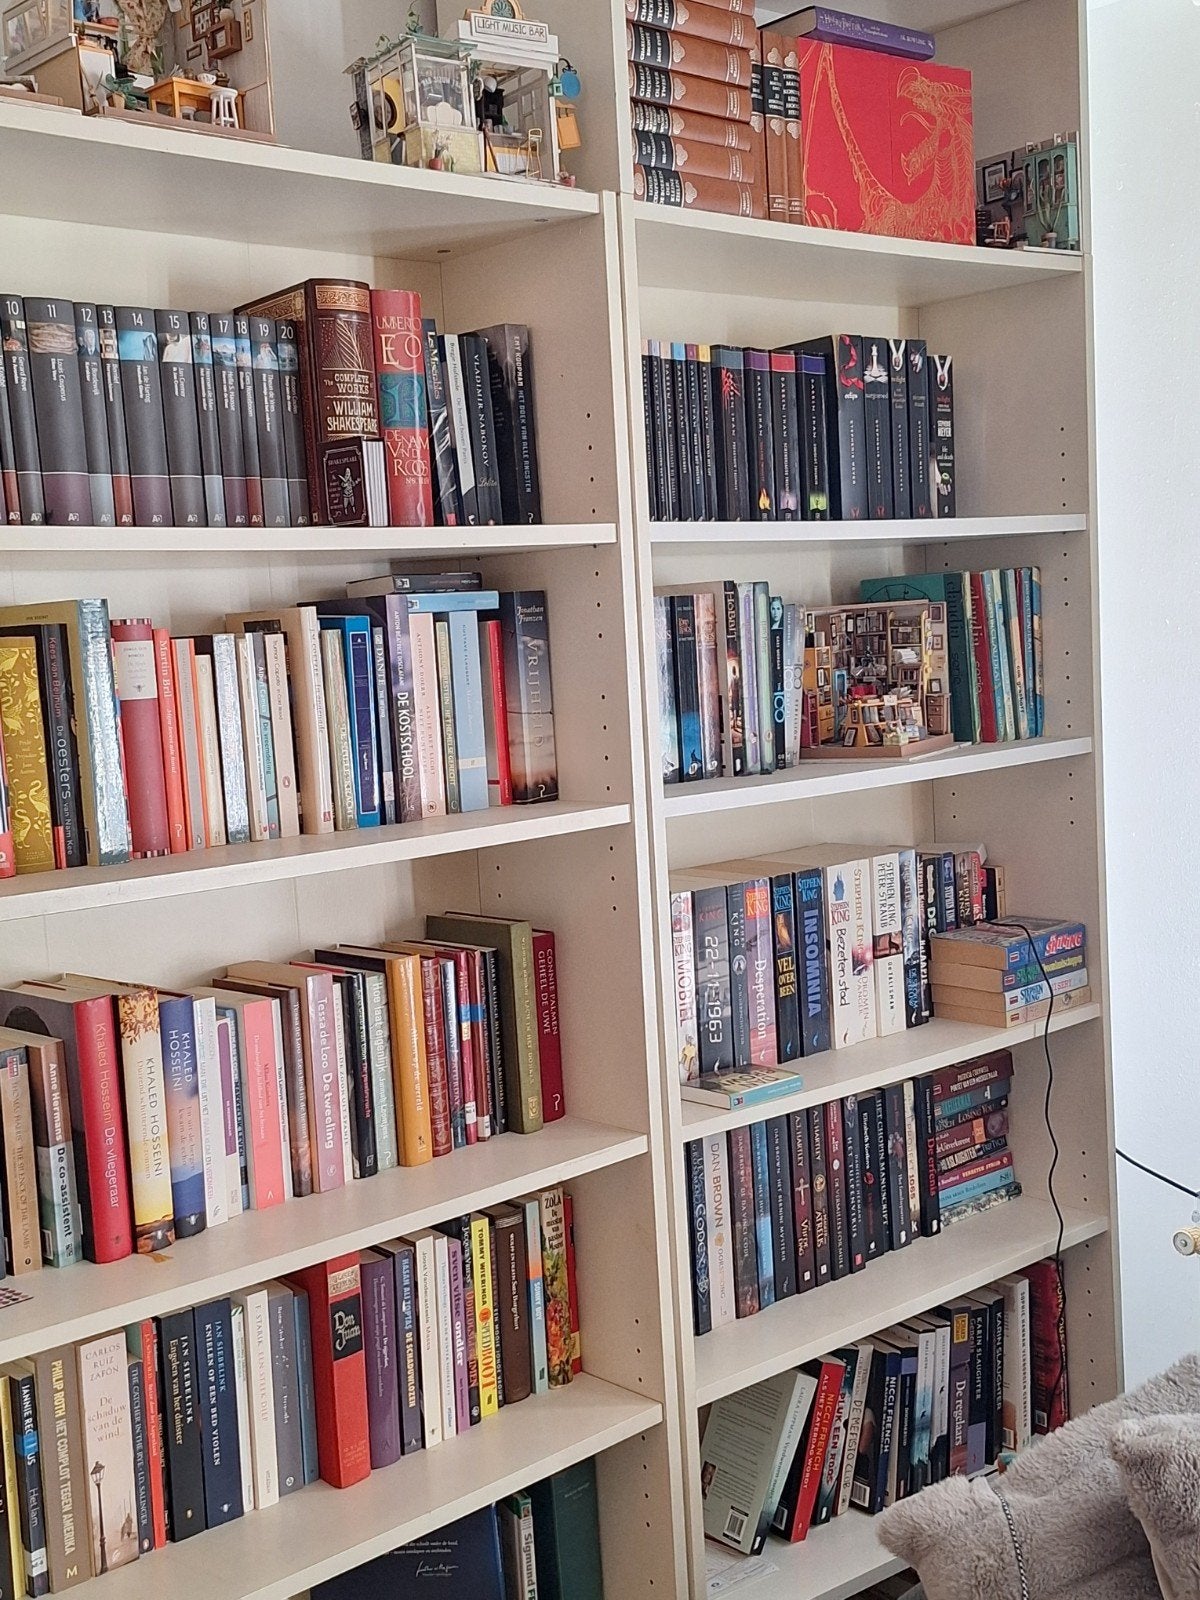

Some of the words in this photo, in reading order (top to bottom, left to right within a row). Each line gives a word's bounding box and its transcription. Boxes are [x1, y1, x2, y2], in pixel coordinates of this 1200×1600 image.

[477, 19, 500, 31] LIGHT
[502, 22, 527, 35] MUSIC
[529, 25, 545, 38] BAR
[6, 301, 19, 316] 10
[47, 304, 57, 318] 11
[81, 308, 92, 323] 12
[102, 310, 113, 324] 13
[132, 312, 144, 326] 14
[169, 315, 180, 329] 15
[196, 317, 207, 331] 16
[218, 320, 229, 333] 17
[236, 321, 247, 335] 18
[259, 323, 270, 337] 19
[281, 326, 293, 340] 20
[334, 374, 370, 385] COMPLETE
[514, 351, 523, 387] KOOPMAN
[336, 384, 370, 395] WORKS
[517, 390, 525, 404] HET
[333, 401, 374, 418] WILLIAM
[473, 354, 484, 410] VLADIMIR
[479, 413, 489, 468] NABOKOV
[518, 404, 526, 424] BOEK
[327, 417, 379, 433] SHAKESPEARE
[521, 441, 529, 460] ALLE
[522, 461, 531, 493] ANGSTEN
[49, 637, 58, 660] Kees
[160, 639, 170, 678] Martin
[50, 661, 58, 678] van
[377, 647, 386, 686] DANTE
[52, 679, 62, 718] Beijnum
[162, 679, 172, 698] Bril
[397, 691, 410, 708] DE
[56, 725, 64, 737] De
[263, 721, 270, 732] De
[263, 733, 273, 775] vreemdeling
[398, 709, 415, 783] KOSTSCHOOL
[57, 738, 73, 799] oesters
[65, 818, 73, 838] Nam
[66, 839, 75, 856] Kee
[877, 863, 886, 889] PETER
[886, 861, 896, 903] STEPHEN
[879, 891, 888, 928] STRAUB
[888, 903, 897, 926] KING
[730, 912, 739, 946] KING
[538, 950, 547, 990] GEHEEL
[547, 949, 555, 991] CONNIE
[803, 909, 821, 1018] INSOMNIA
[373, 982, 384, 1003] Hoe
[541, 993, 548, 1006] DE
[705, 936, 722, 1043] 22-11-1963
[752, 960, 769, 1039] Desperation
[839, 980, 849, 1006] stad
[317, 997, 329, 1030] Tessa
[374, 1006, 385, 1027] laat
[543, 1011, 551, 1035] UWE
[550, 993, 559, 1036] PALMEN
[95, 1023, 108, 1066] Khaled
[321, 1031, 330, 1044] de
[169, 1029, 183, 1092] HOSSEINI
[182, 1031, 194, 1083] KHALED
[321, 1045, 331, 1069] Loo
[375, 1030, 387, 1073] eigenlijk
[49, 1063, 59, 1090] Anne
[146, 1057, 158, 1109] KHALED
[323, 1072, 333, 1092] De
[99, 1069, 112, 1124] Hosseini
[51, 1092, 64, 1141] Hermans
[323, 1092, 336, 1149] tweeling
[104, 1126, 116, 1146] De
[150, 1114, 163, 1177] HOSSEINI
[237, 1130, 245, 1157] LEVEN
[876, 1123, 885, 1162] CHOPIN
[57, 1147, 66, 1164] De
[710, 1142, 721, 1172] DAN
[104, 1149, 120, 1208] vliegeraar
[59, 1166, 73, 1238] co-assistent
[545, 1194, 561, 1209] ZOLA
[712, 1174, 723, 1228] BROWN
[848, 1163, 857, 1239] TULPENVIRUS
[879, 1163, 888, 1226] MANUSCRIPT
[478, 1228, 486, 1261] TOMMY
[401, 1259, 411, 1286] HASAN
[451, 1250, 460, 1283] sven
[480, 1262, 488, 1306] WIERINGA
[453, 1285, 462, 1317] vitse
[214, 1321, 223, 1339] JAN
[334, 1311, 356, 1331] Don
[180, 1335, 189, 1358] JAN
[204, 1323, 215, 1367] KNIELEN
[405, 1331, 414, 1342] DE
[454, 1320, 465, 1366] ondier
[86, 1344, 121, 1360] CARLOS
[94, 1356, 114, 1369] RUIZ
[168, 1339, 180, 1377] Engelen
[51, 1360, 65, 1391] PHILIP
[131, 1367, 140, 1384] THE
[208, 1369, 217, 1383] OP
[216, 1341, 227, 1393] SIEBELINK
[406, 1343, 416, 1408] SCHADUWLOZEN
[171, 1378, 179, 1395] van
[182, 1361, 194, 1425] SIEBELINK
[209, 1386, 218, 1405] EEN
[820, 1373, 829, 1391] ALS
[887, 1376, 897, 1407] NICCI
[956, 1379, 967, 1397] De
[53, 1392, 66, 1418] ROTH
[132, 1385, 142, 1420] CATCHER
[173, 1396, 182, 1412] het
[818, 1392, 827, 1409] HET
[822, 1393, 835, 1424] NICCI
[854, 1400, 863, 1415] DE
[55, 1419, 68, 1437] HET
[174, 1413, 185, 1445] duister
[210, 1408, 219, 1427] BED
[883, 1409, 894, 1453] FRENCH
[951, 1400, 965, 1446] regelaars
[810, 1411, 823, 1455] ZATERDAG
[831, 1426, 840, 1450] EEN
[846, 1417, 860, 1461] MEFISTO
[57, 1439, 70, 1481] COMPLOT
[211, 1429, 221, 1466] VIOLEN
[813, 1427, 829, 1471] FRENCH
[803, 1458, 814, 1490] WORDT
[842, 1464, 853, 1489] CLUB
[28, 1487, 39, 1505] Het
[60, 1482, 72, 1512] TEGEN
[138, 1483, 148, 1526] SALINGER
[30, 1508, 40, 1528] lam
[62, 1513, 76, 1556] AMERIKA
[523, 1533, 536, 1588] Sigmund
